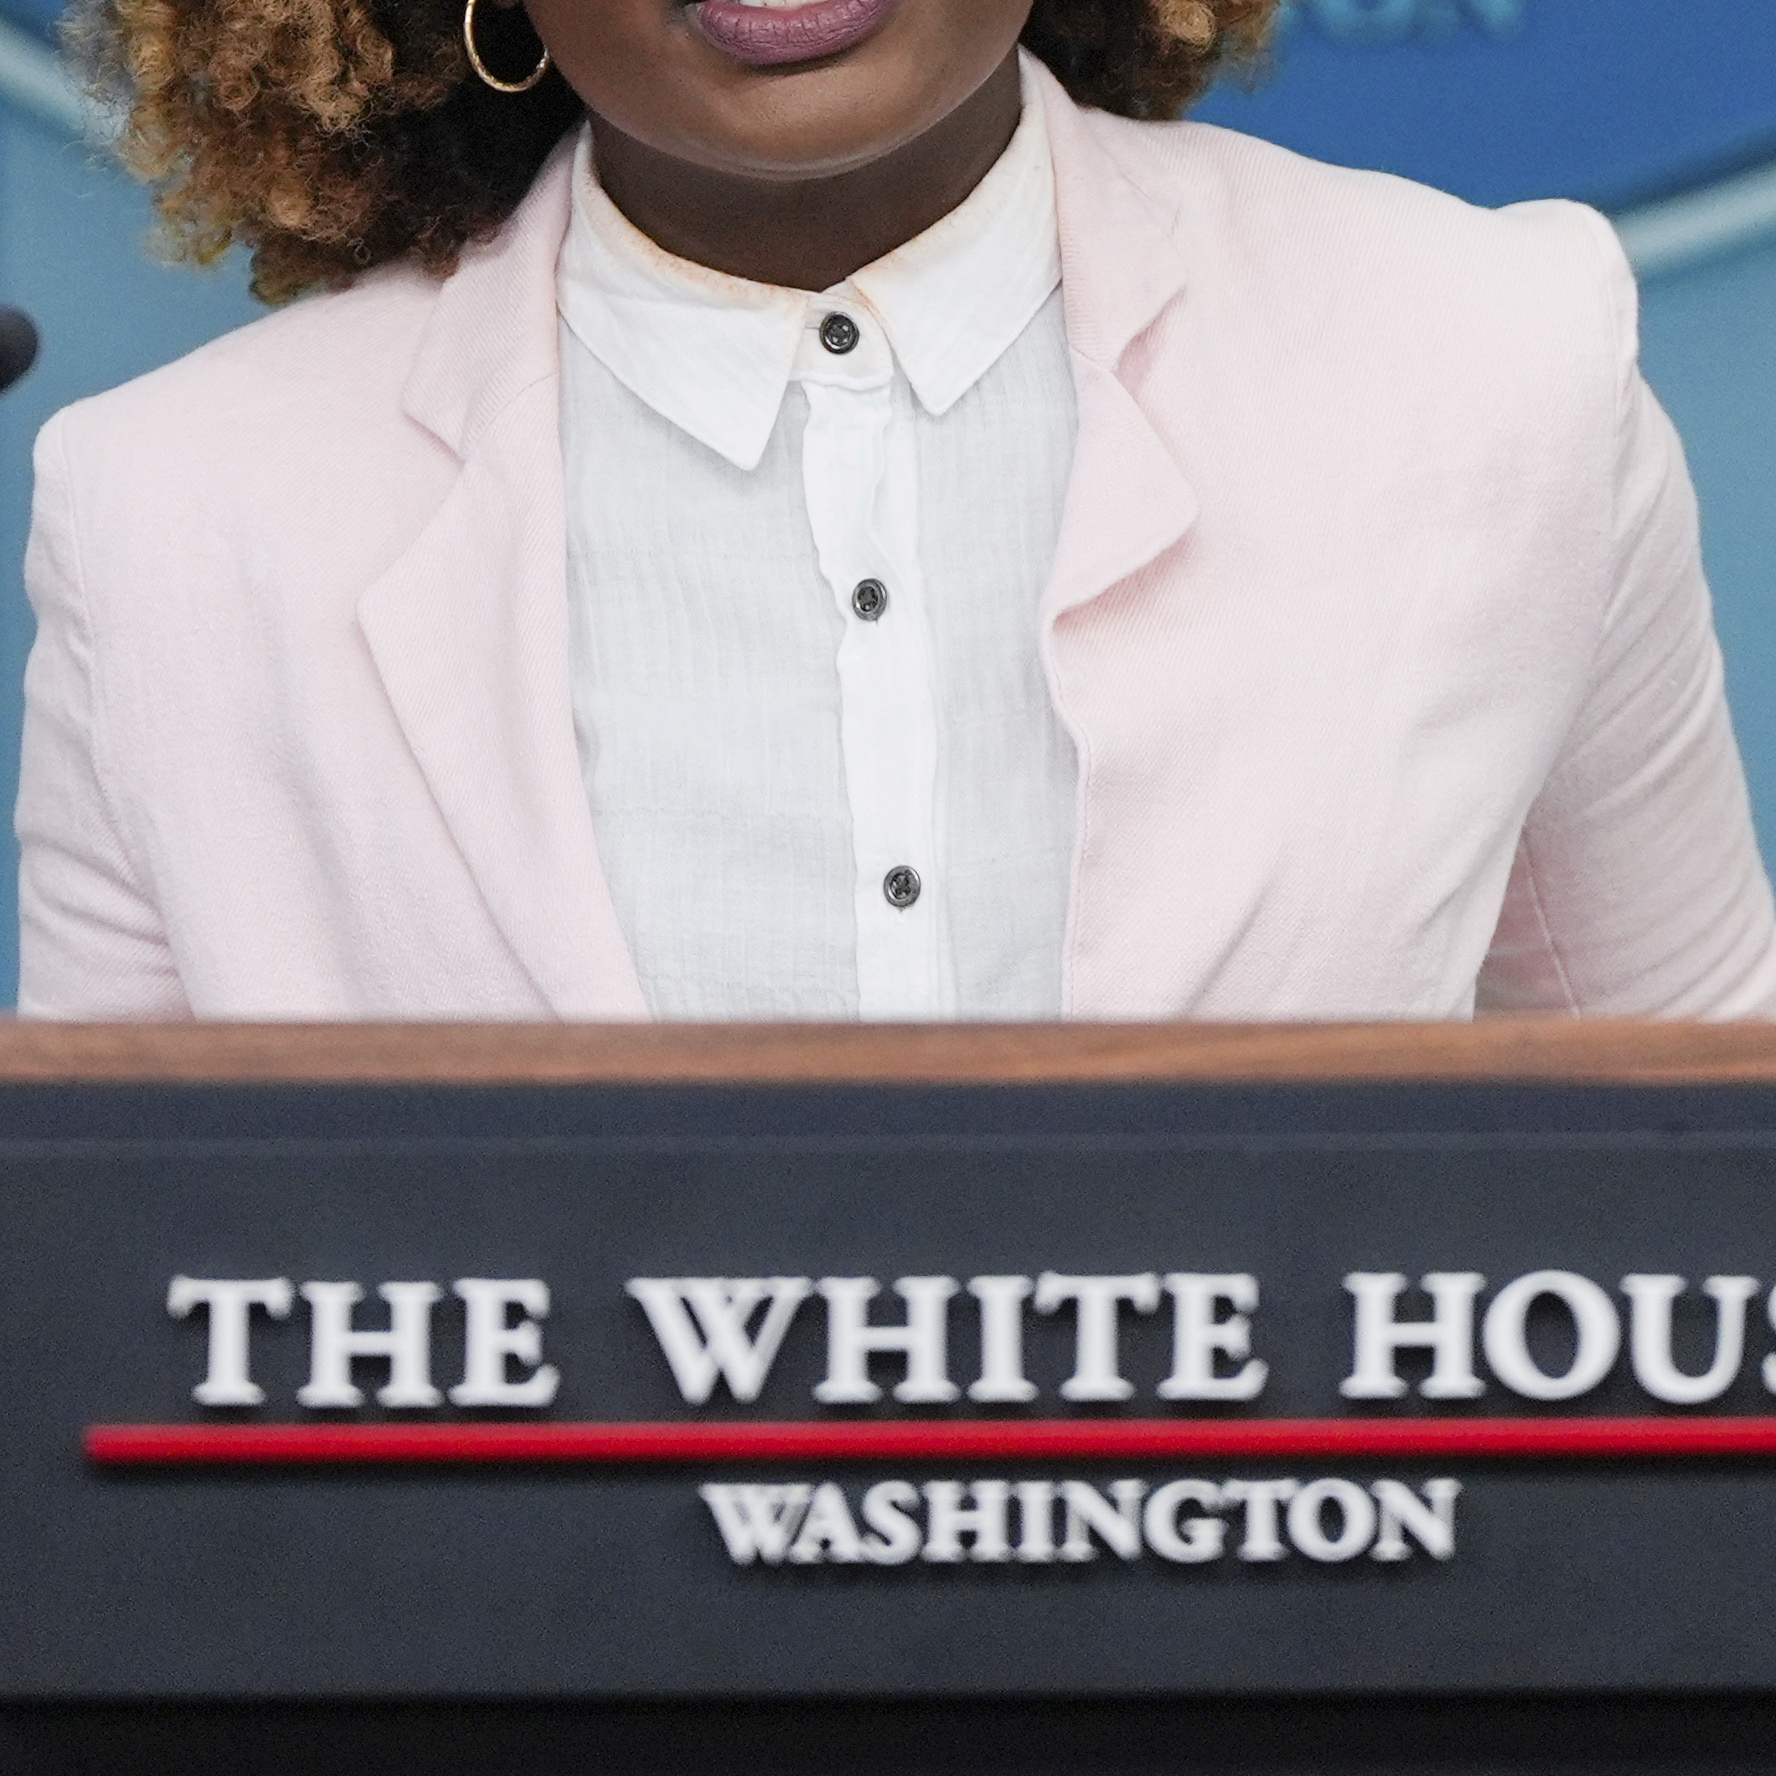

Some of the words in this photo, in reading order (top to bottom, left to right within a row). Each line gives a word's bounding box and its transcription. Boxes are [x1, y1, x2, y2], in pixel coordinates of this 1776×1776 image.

[167, 1275, 562, 1408] THE
[626, 1271, 1270, 1406] WHITE
[699, 1478, 1463, 1564] WASHINGTON
